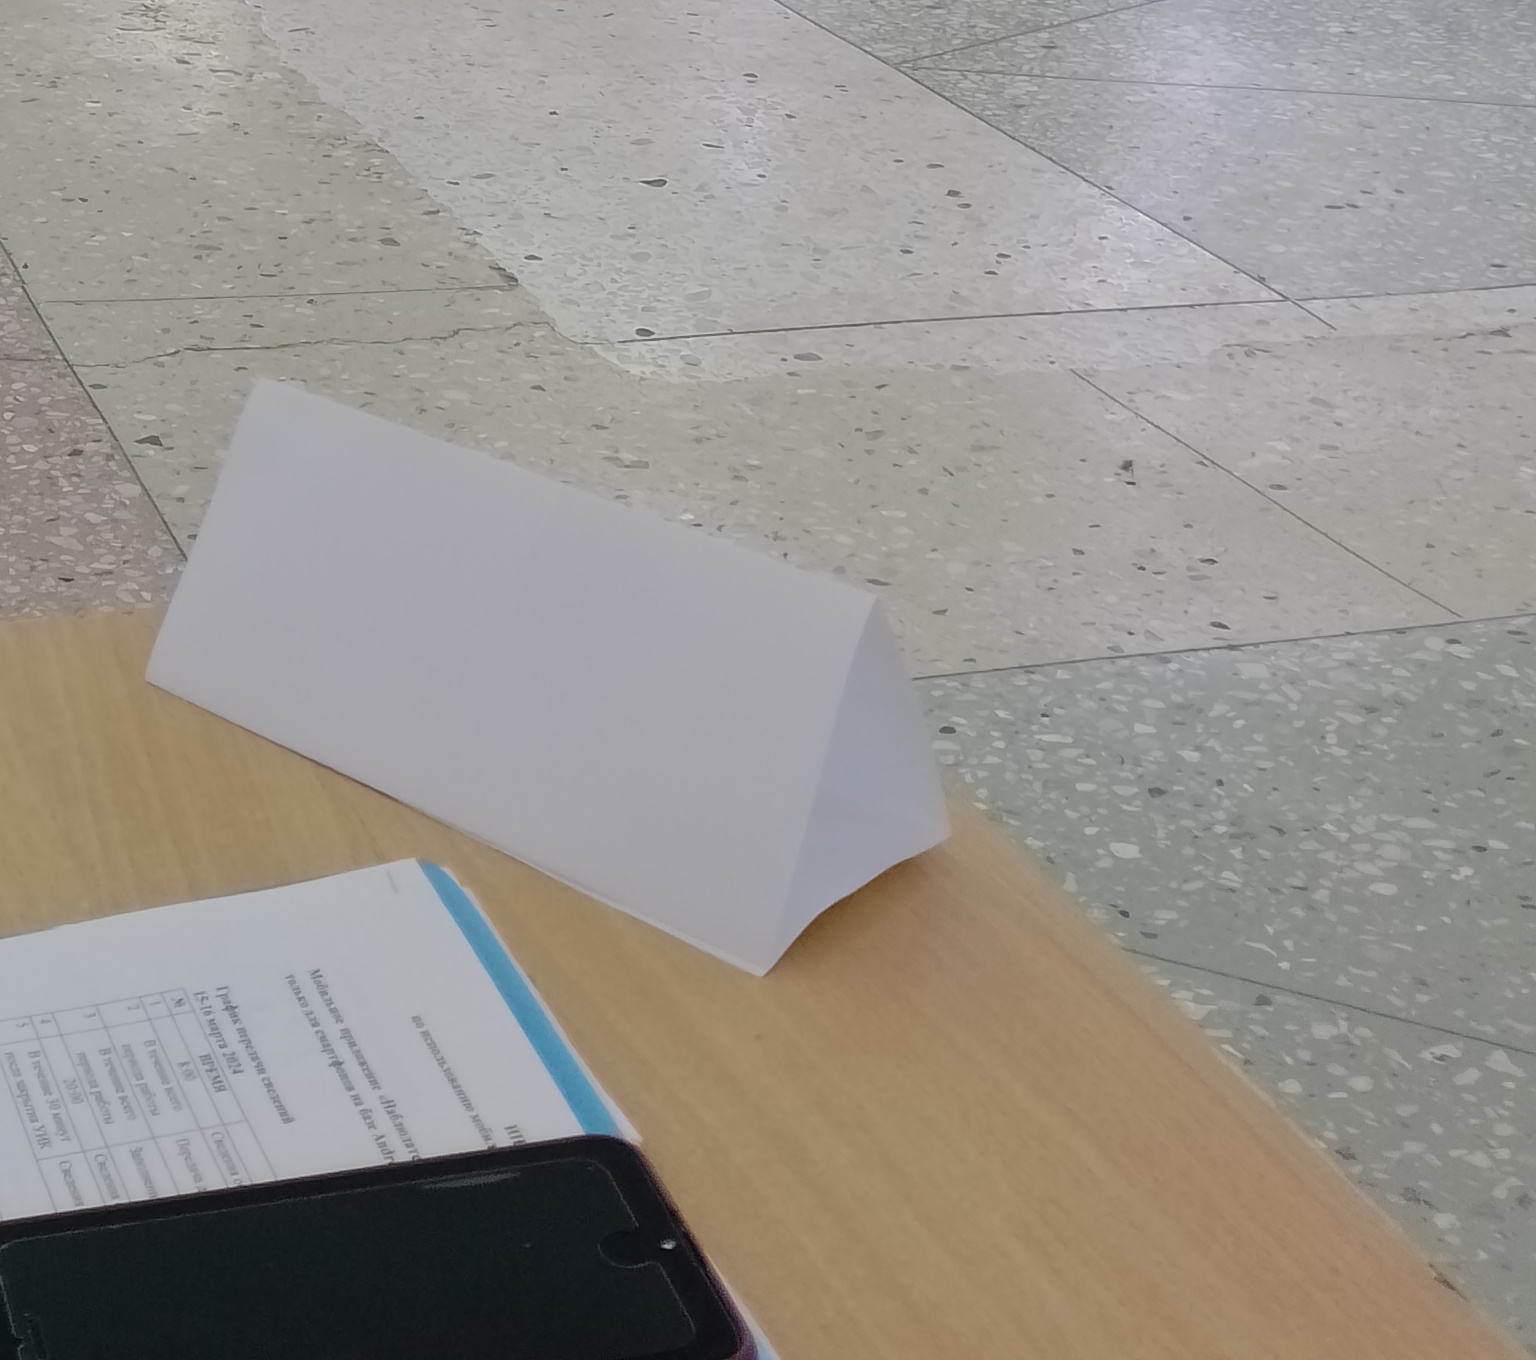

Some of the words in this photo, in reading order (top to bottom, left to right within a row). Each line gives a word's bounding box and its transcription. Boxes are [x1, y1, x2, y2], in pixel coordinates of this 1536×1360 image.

[192, 990, 215, 1017] 15-16
[205, 1017, 228, 1050] марта
[221, 1050, 244, 1075] 2024
[309, 968, 344, 1024] Мобильное
[338, 1027, 381, 1090] приложение
[214, 985, 241, 1025] График
[235, 1026, 267, 1075] передачи
[260, 1076, 295, 1124] сведений
[284, 973, 309, 1009] только
[303, 1009, 321, 1028] для
[314, 1028, 355, 1092] смартфонов
[349, 1092, 364, 1107] на
[358, 1107, 377, 1130] базе
[61, 1077, 84, 1105] 20:00
[198, 1053, 227, 1093] ВРЕМЯ
[3, 1051, 22, 1078] после
[14, 1079, 39, 1124] закрытия
[31, 1124, 52, 1150] УИК
[44, 1097, 62, 1111] 30
[87, 1089, 114, 1125] работы
[117, 1094, 137, 1121] всего
[134, 1081, 160, 1116] работы
[163, 1085, 183, 1111] всего
[51, 1111, 71, 1142] минут
